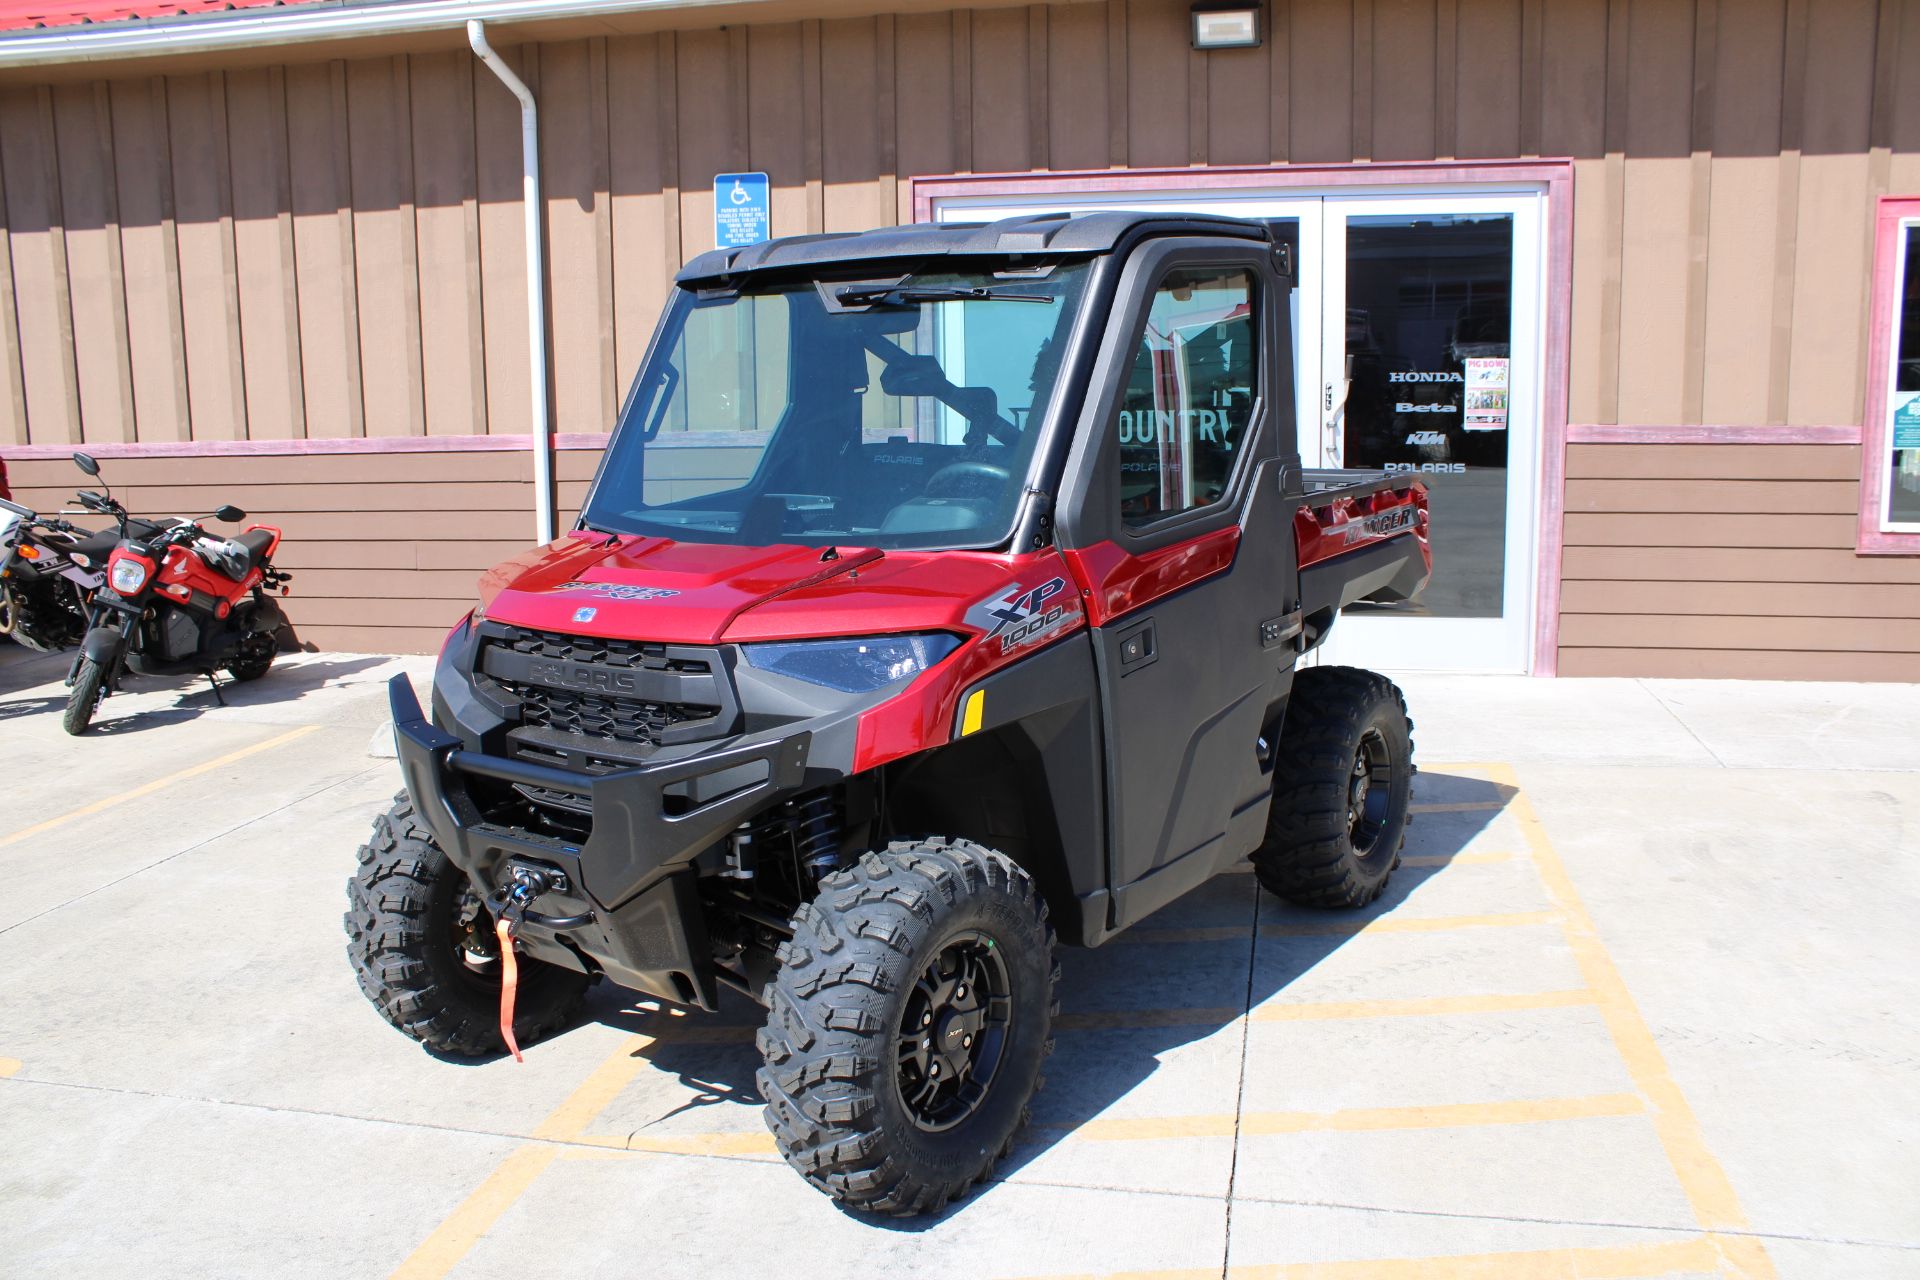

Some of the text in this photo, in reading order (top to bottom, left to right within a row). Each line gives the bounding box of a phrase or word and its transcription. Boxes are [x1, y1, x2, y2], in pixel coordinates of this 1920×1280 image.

[1468, 360, 1507, 368] PIG BOWL
[1389, 371, 1464, 383] HONDA
[1395, 402, 1457, 413] Beta
[1119, 408, 1233, 447] OUNTRY
[1405, 431, 1447, 445] KTM
[874, 454, 924, 465] POLARIS
[1384, 462, 1466, 474] POLARIS
[979, 576, 1066, 645] XP
[1001, 605, 1063, 651] 1000
[529, 661, 637, 695] POLARIS
